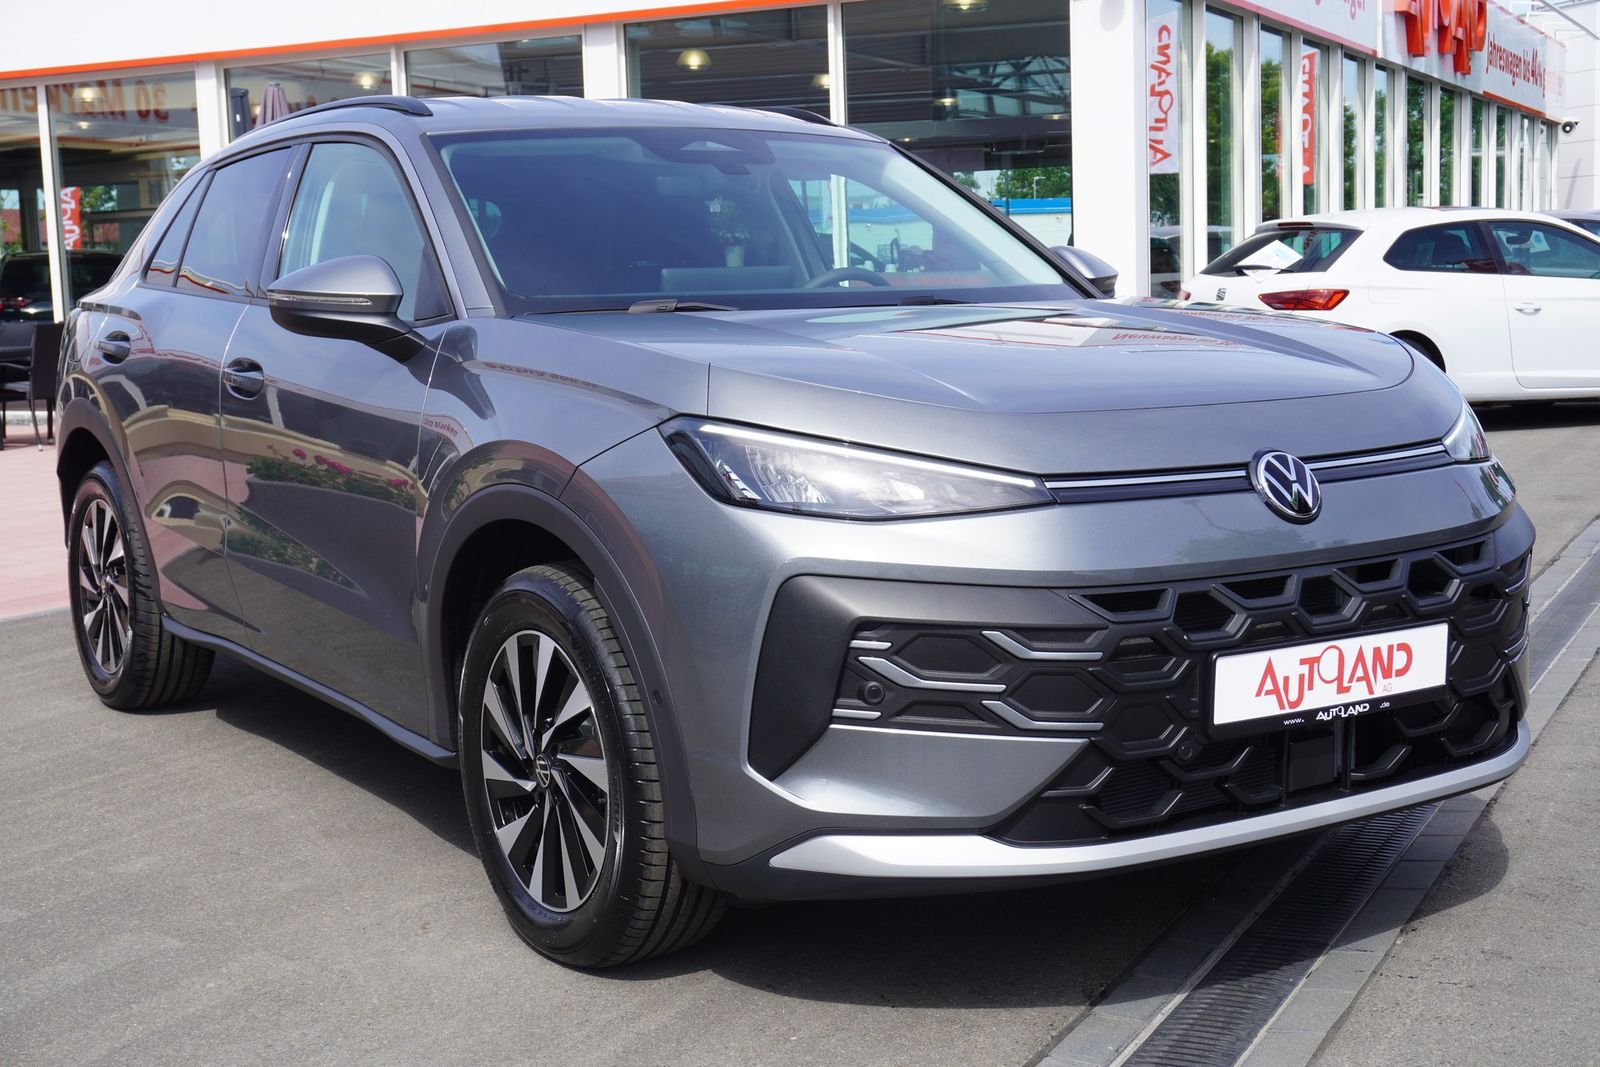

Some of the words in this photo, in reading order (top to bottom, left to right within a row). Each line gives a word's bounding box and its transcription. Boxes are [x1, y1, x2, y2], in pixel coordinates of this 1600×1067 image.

[1486, 31, 1522, 87] Jahreswagen
[1522, 49, 1530, 83] bis
[1283, 718, 1305, 726] www.
